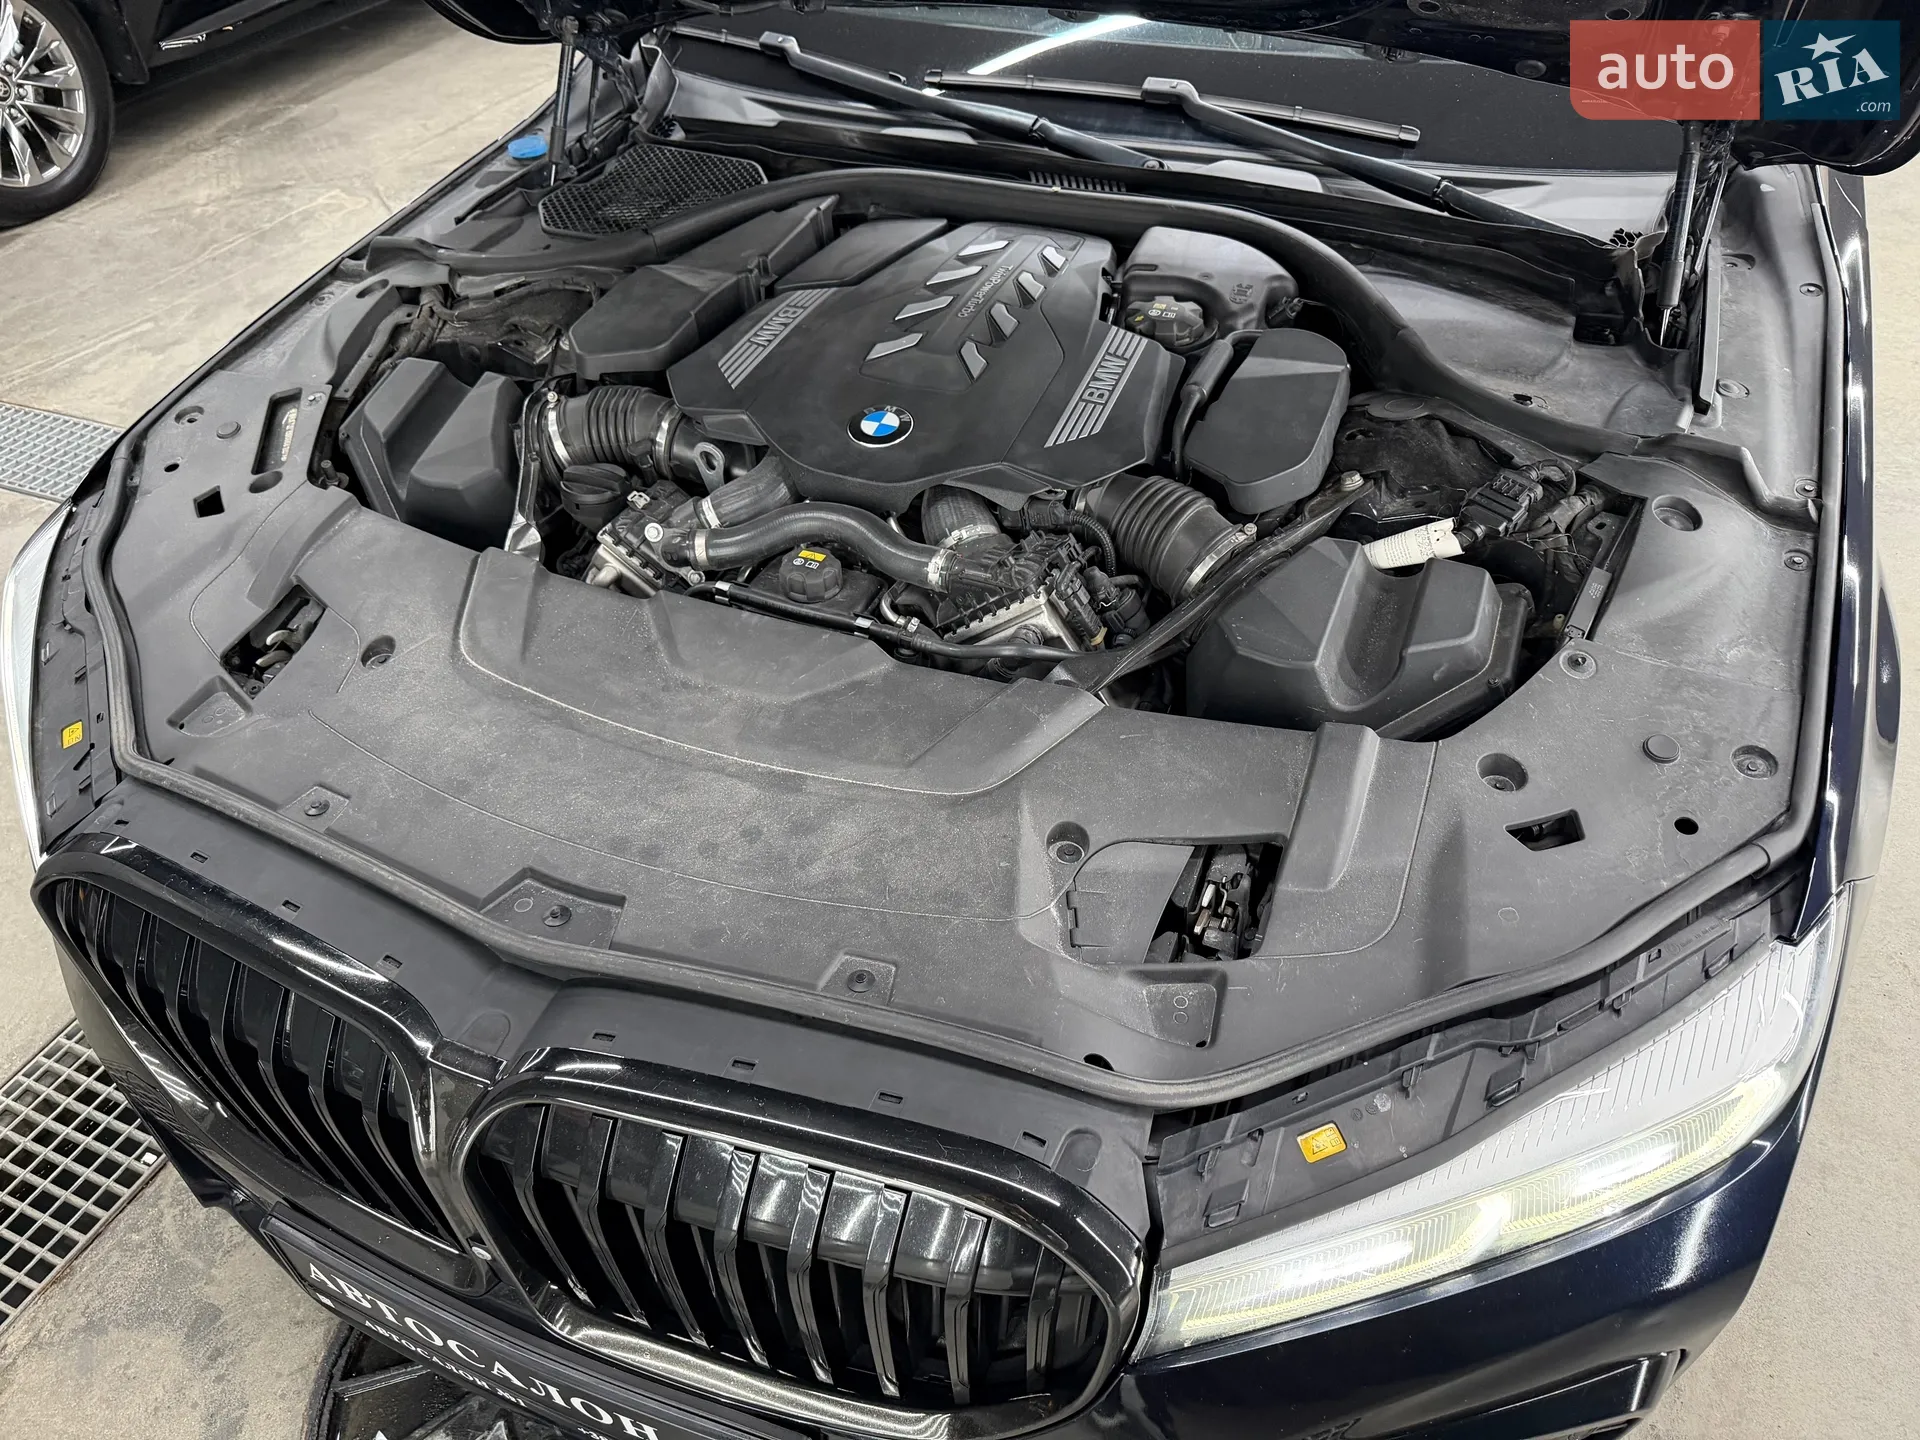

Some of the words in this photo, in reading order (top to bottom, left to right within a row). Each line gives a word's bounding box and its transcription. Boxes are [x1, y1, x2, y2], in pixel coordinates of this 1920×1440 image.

[749, 307, 805, 347] BMW
[1081, 354, 1128, 404] BMW
[863, 405, 911, 422] BMW
[309, 1262, 659, 1440] АВТОСАЛОН
